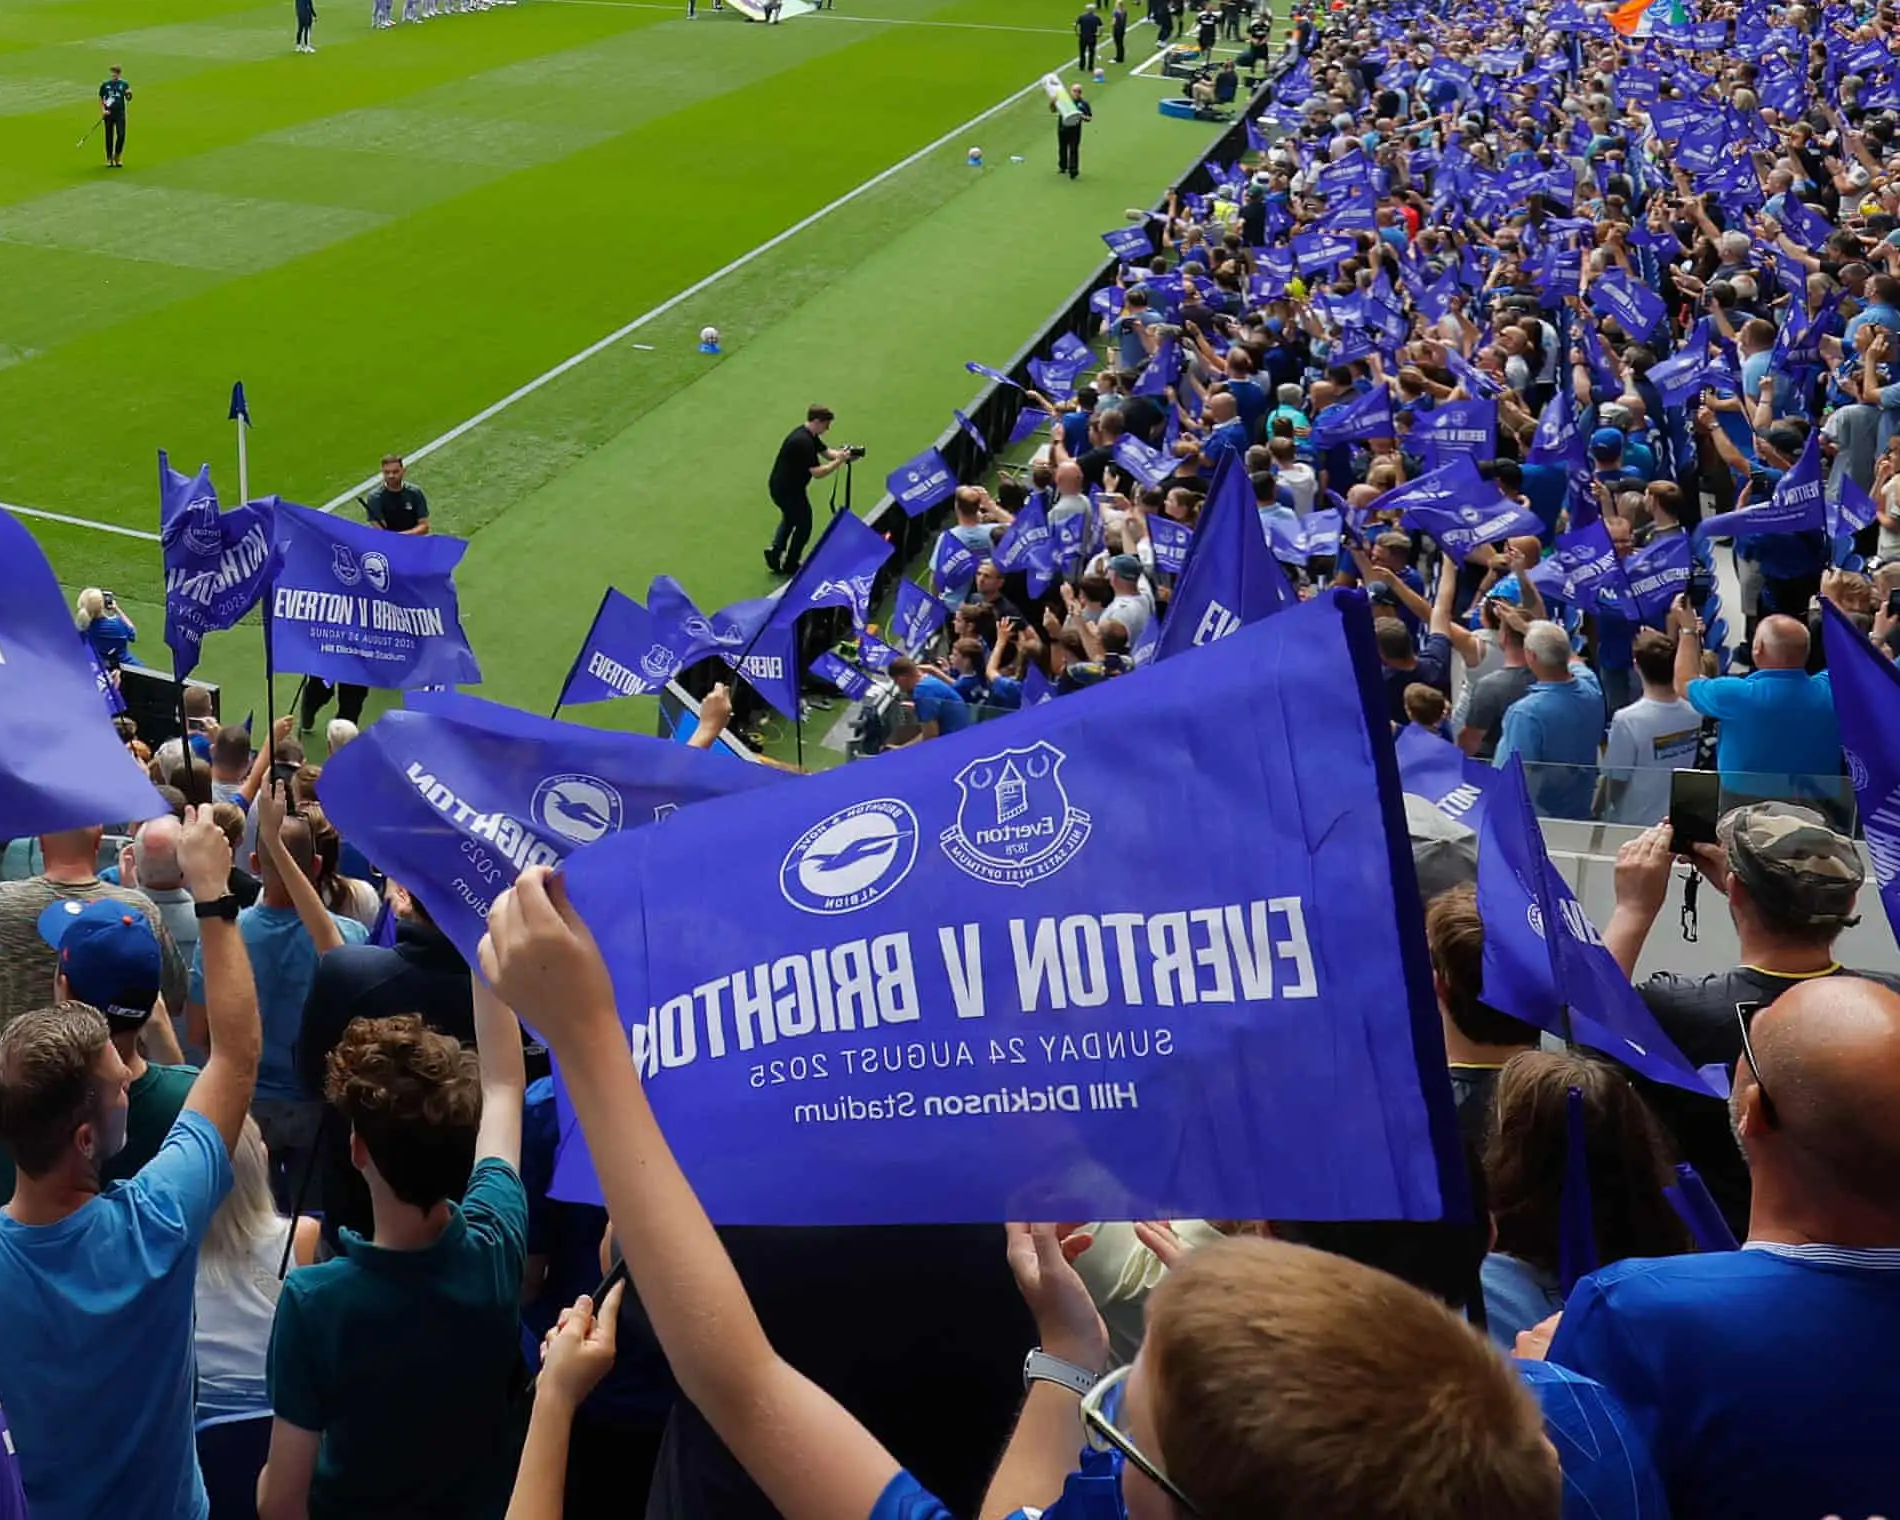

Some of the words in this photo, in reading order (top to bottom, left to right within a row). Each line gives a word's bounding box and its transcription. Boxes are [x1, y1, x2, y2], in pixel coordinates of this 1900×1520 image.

[274, 587, 354, 627] EVERTON
[358, 595, 369, 628] V
[372, 599, 445, 637] BRIGHTON
[309, 626, 348, 641] SUNDAY
[589, 651, 649, 696] EVERTON
